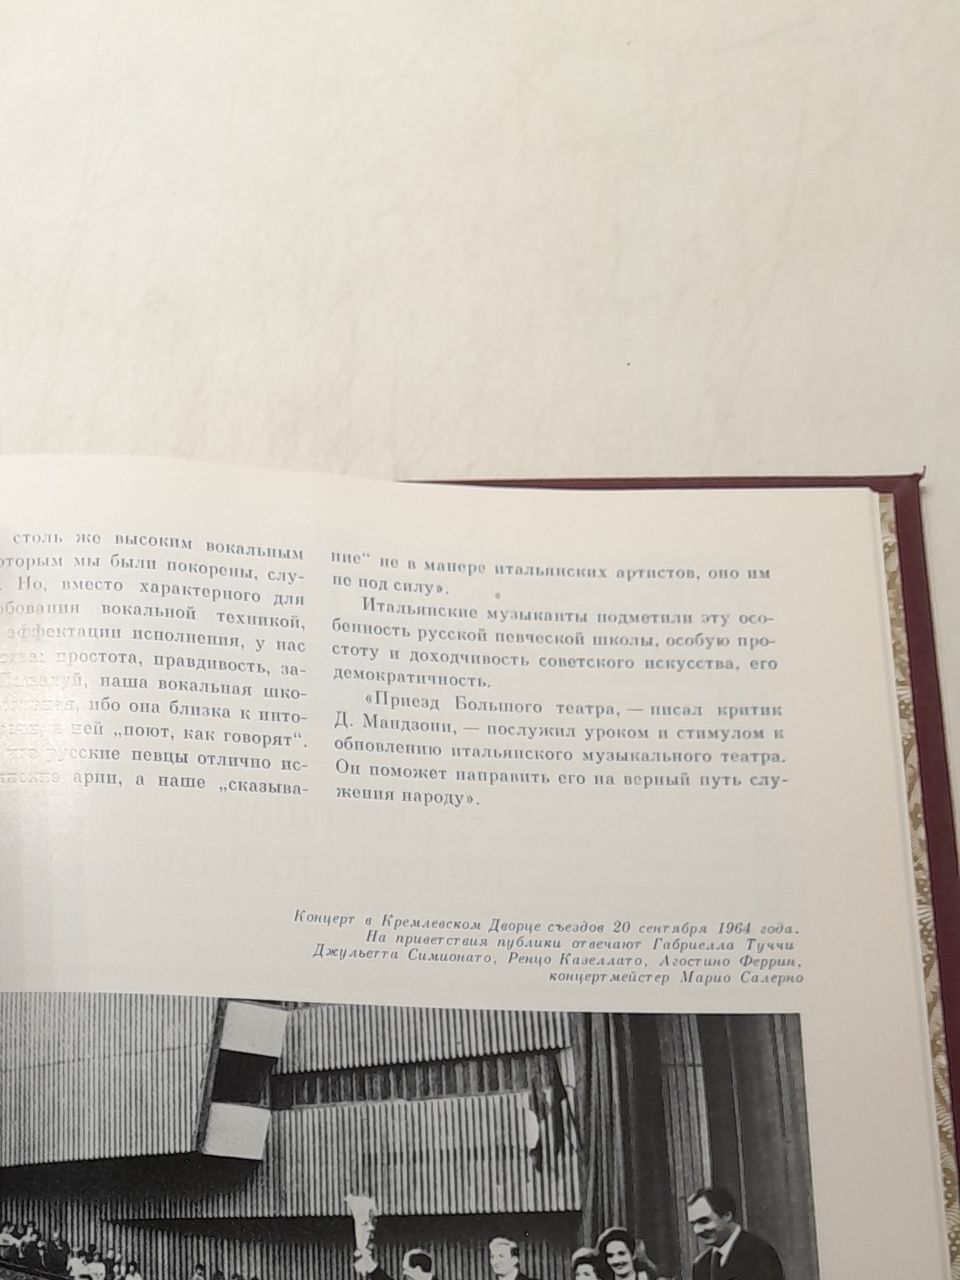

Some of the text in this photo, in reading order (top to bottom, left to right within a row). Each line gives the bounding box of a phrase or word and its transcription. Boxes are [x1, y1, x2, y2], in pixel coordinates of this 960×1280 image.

[13, 534, 62, 544] столь
[76, 534, 101, 544] же
[115, 534, 192, 549] высоким
[206, 541, 303, 560] вокальным
[74, 557, 100, 567] мы
[111, 553, 156, 570] были
[167, 561, 258, 581] покорены,
[268, 571, 304, 585] слу-
[380, 557, 398, 568] не
[408, 560, 416, 569] в
[425, 561, 486, 576] манере
[495, 565, 607, 578] итальянских
[616, 569, 700, 582] артистов,
[708, 569, 739, 579] оно
[748, 569, 770, 579] им
[18, 576, 47, 592] Но,
[62, 581, 123, 591] вместо
[139, 582, 260, 603] характерного
[273, 594, 304, 606] для
[333, 576, 351, 586] не
[359, 578, 388, 591] под
[101, 604, 196, 620] вокальной
[216, 612, 305, 631] техникой,
[363, 596, 774, 627] Итальянские музыканты подметили эту осо-
[133, 630, 244, 650] исполнения,
[255, 639, 265, 652] у
[277, 641, 306, 652] нас
[332, 618, 776, 650] бенность русской певческой школы, особую про-
[56, 652, 142, 667] простота,
[154, 655, 270, 676] правдивость,
[281, 665, 306, 676] за-
[332, 645, 379, 661] стоту
[390, 650, 399, 660] и
[410, 651, 529, 666] доходчивость
[539, 657, 634, 669] советского
[750, 660, 778, 670] его
[100, 677, 147, 688] наша
[158, 679, 252, 696] вокальная
[264, 688, 307, 700] шко-
[333, 668, 491, 688] демократичность.
[89, 696, 308, 723] ибо она близка к инто-
[366, 690, 782, 719] «Приезд Большого театра, писал критик
[184, 729, 215, 741] как
[334, 711, 784, 742] Д. Мандзони, послужил уроком и стимулом к
[131, 750, 188, 765] певцы
[198, 754, 271, 769] отлично
[281, 760, 308, 771] ис-
[335, 736, 786, 766] обновлению итальянского музыкального театра.
[73, 772, 122, 787] арии,
[136, 775, 144, 785] а
[158, 776, 205, 789] наше
[336, 758, 788, 790] Он поможет направить его на верный путь слу-
[336, 787, 479, 808] жения народу».
[294, 909, 799, 937] Концерт в Кремлевском Дворце съездов 20 сентября 1964 года.
[366, 930, 794, 953] На приветствия публики отвечают Габриелла Туччи
[312, 943, 398, 960] Джульетта
[408, 948, 496, 966] Симионато,
[508, 952, 551, 967] Ренцо
[659, 955, 730, 966] Агостино
[549, 971, 804, 987] концертмейстер Марио Салерно
